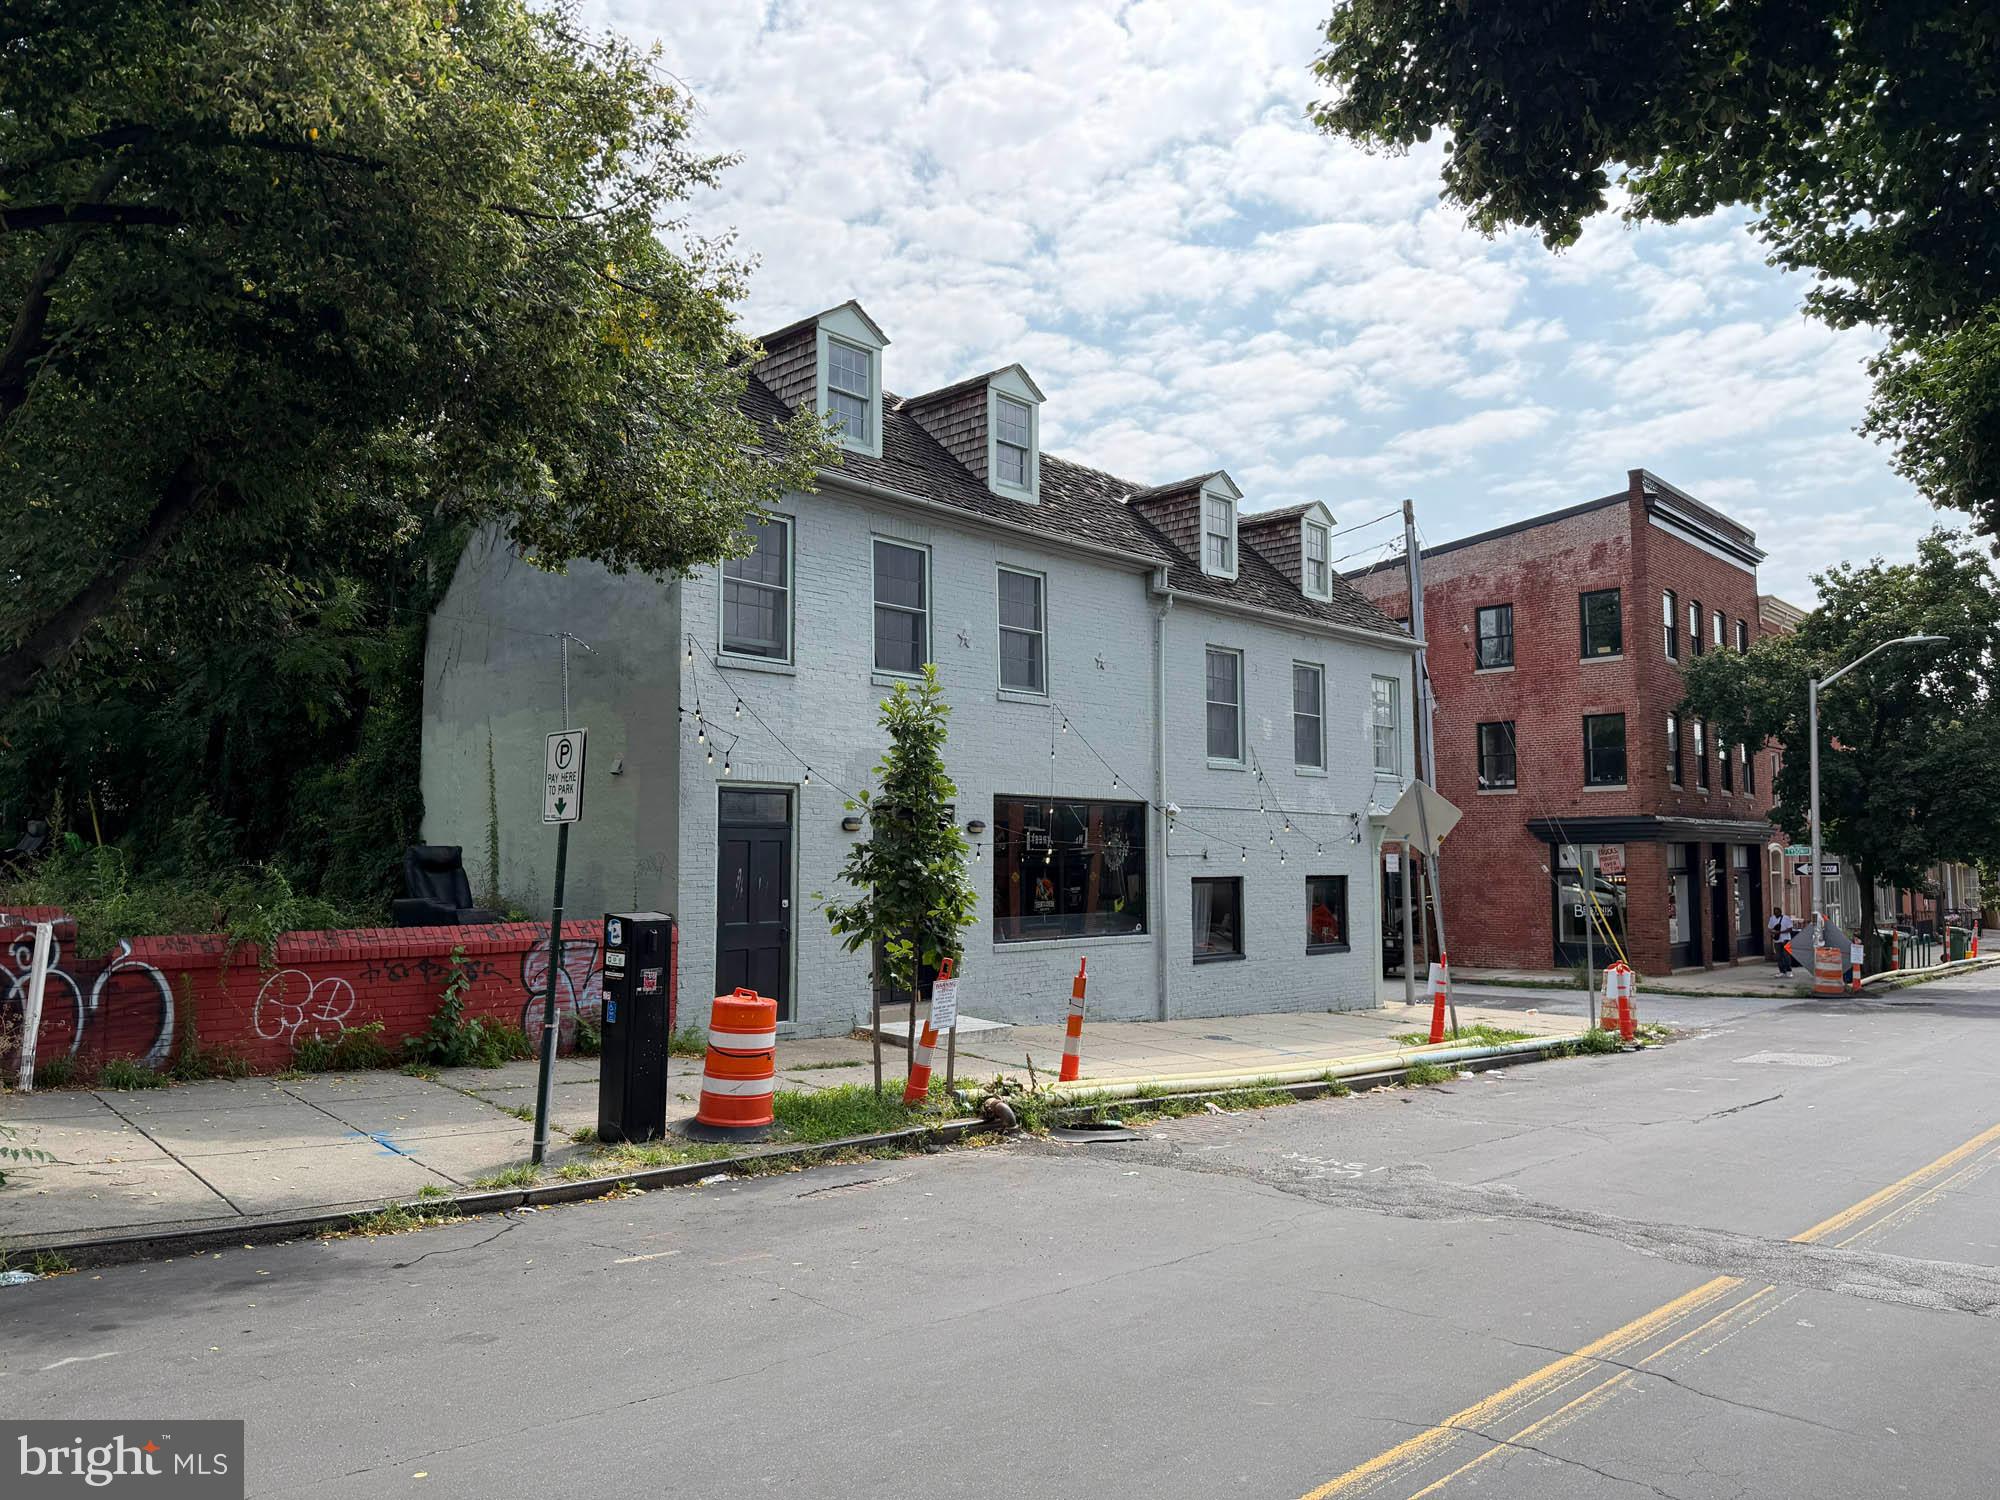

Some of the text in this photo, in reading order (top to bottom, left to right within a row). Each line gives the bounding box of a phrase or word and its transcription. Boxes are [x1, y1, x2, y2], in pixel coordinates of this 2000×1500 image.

[560, 744, 570, 765] P
[547, 771, 577, 784] PAY HERE
[549, 783, 574, 796] TO PARK
